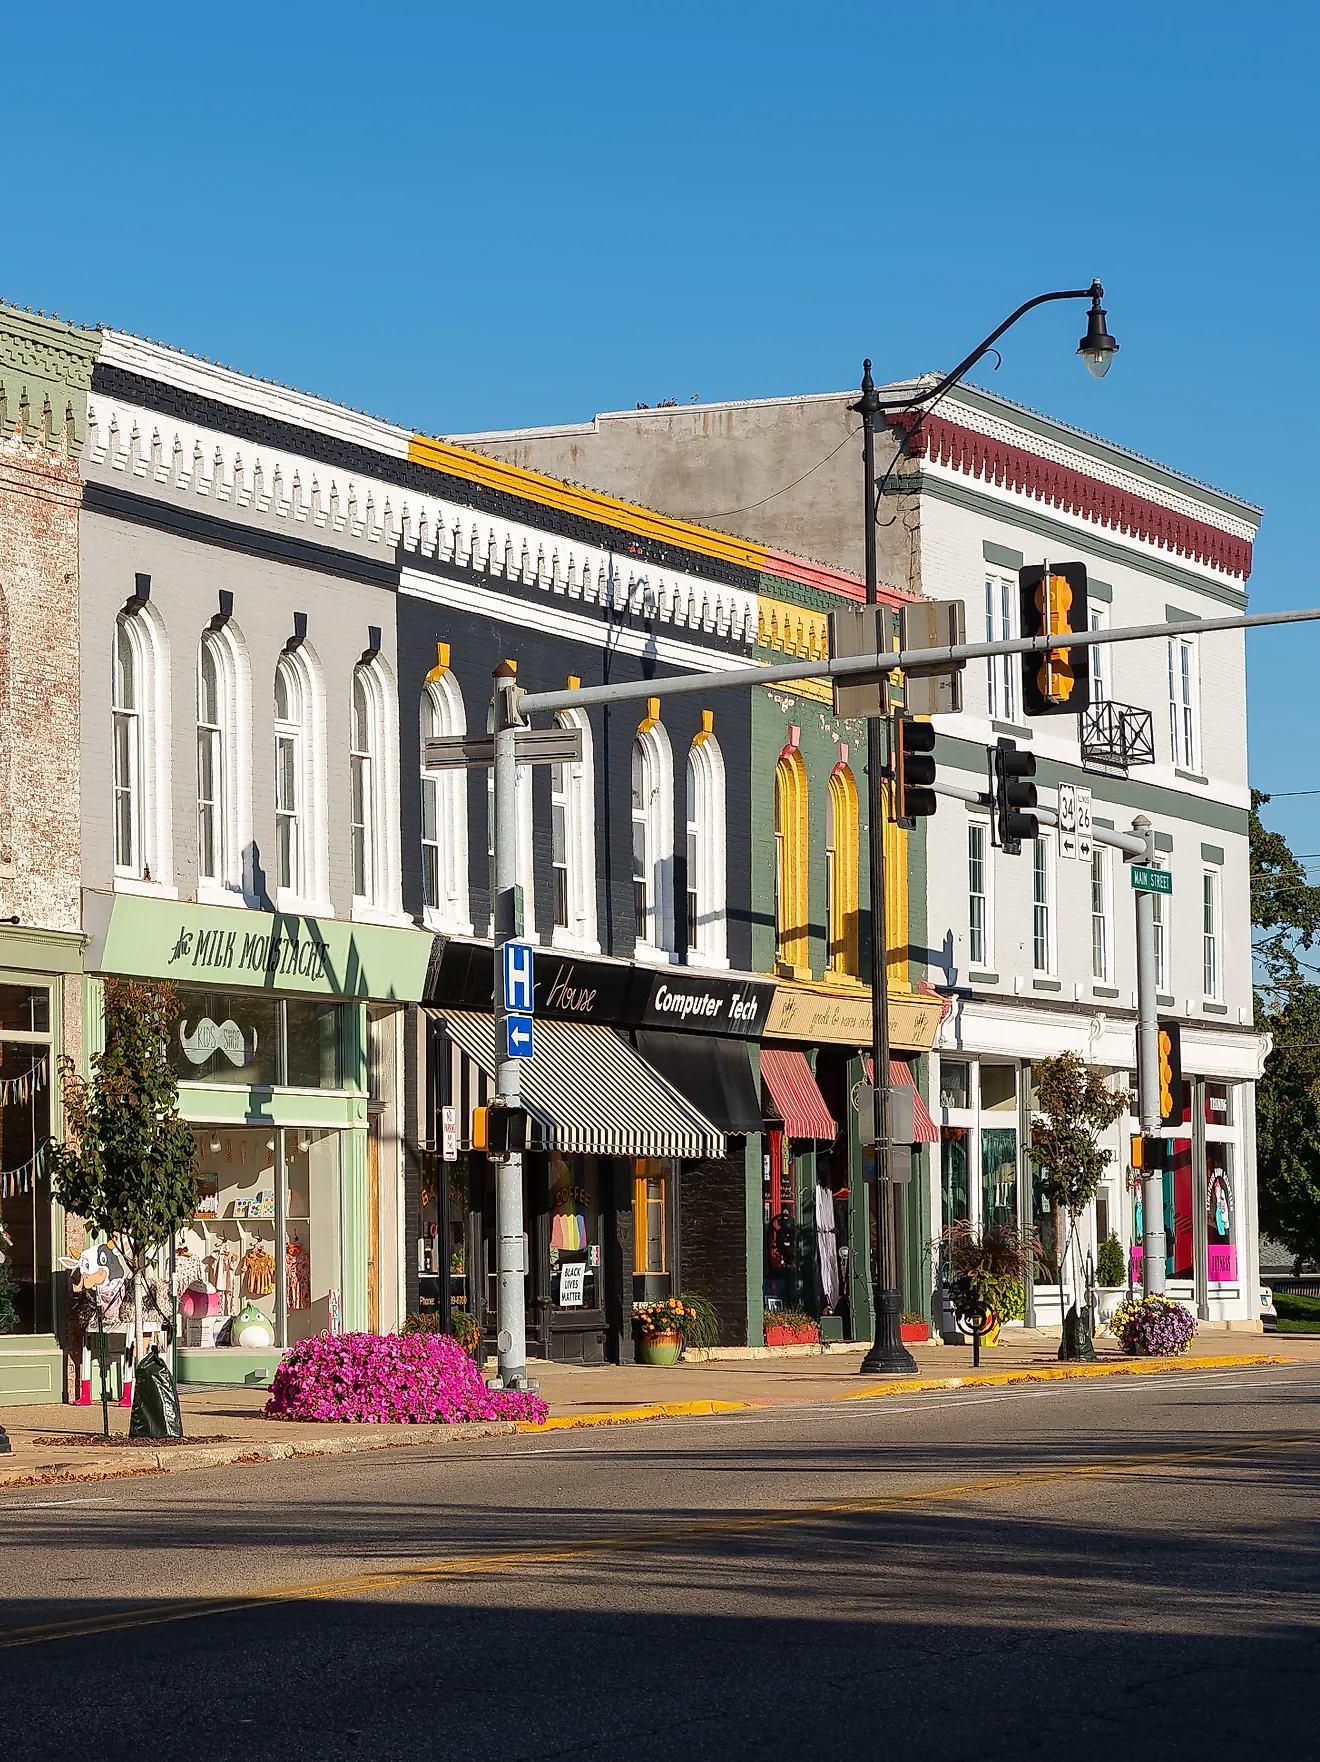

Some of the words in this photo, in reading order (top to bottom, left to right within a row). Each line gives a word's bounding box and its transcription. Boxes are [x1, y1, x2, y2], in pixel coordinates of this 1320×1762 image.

[1062, 796, 1074, 820] 34
[1078, 806, 1090, 828] 26
[1134, 870, 1148, 886] MAIN
[1150, 873, 1169, 889] STREET
[192, 929, 237, 969] MILK
[238, 932, 330, 981] MOUSTACHE
[508, 947, 531, 1008] H
[546, 964, 597, 1012] House
[655, 984, 723, 1020] Computer
[728, 993, 758, 1020] Tech
[197, 1025, 216, 1049] KIDS
[223, 1028, 240, 1050] SHOP
[556, 1186, 591, 1208] COFFEE
[564, 1267, 582, 1278] BLACK
[564, 1279, 579, 1290] LIVES
[561, 1291, 582, 1303] MATTER
